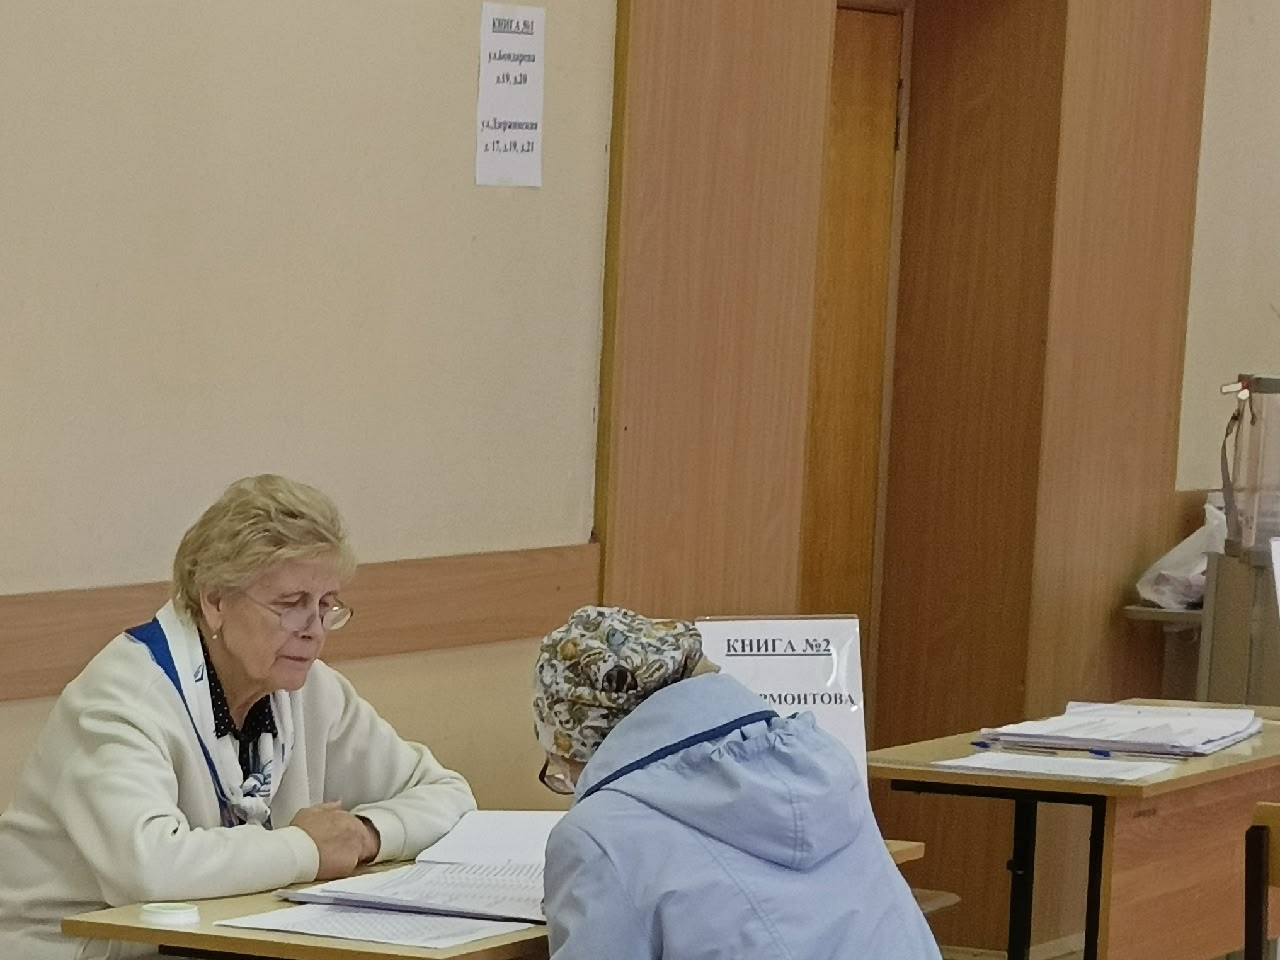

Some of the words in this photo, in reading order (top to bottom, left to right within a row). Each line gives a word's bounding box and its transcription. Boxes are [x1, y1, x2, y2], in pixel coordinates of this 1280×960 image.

[492, 17, 520, 32] КНИГА
[726, 638, 797, 653] КНИГА
[802, 638, 832, 653] №2
